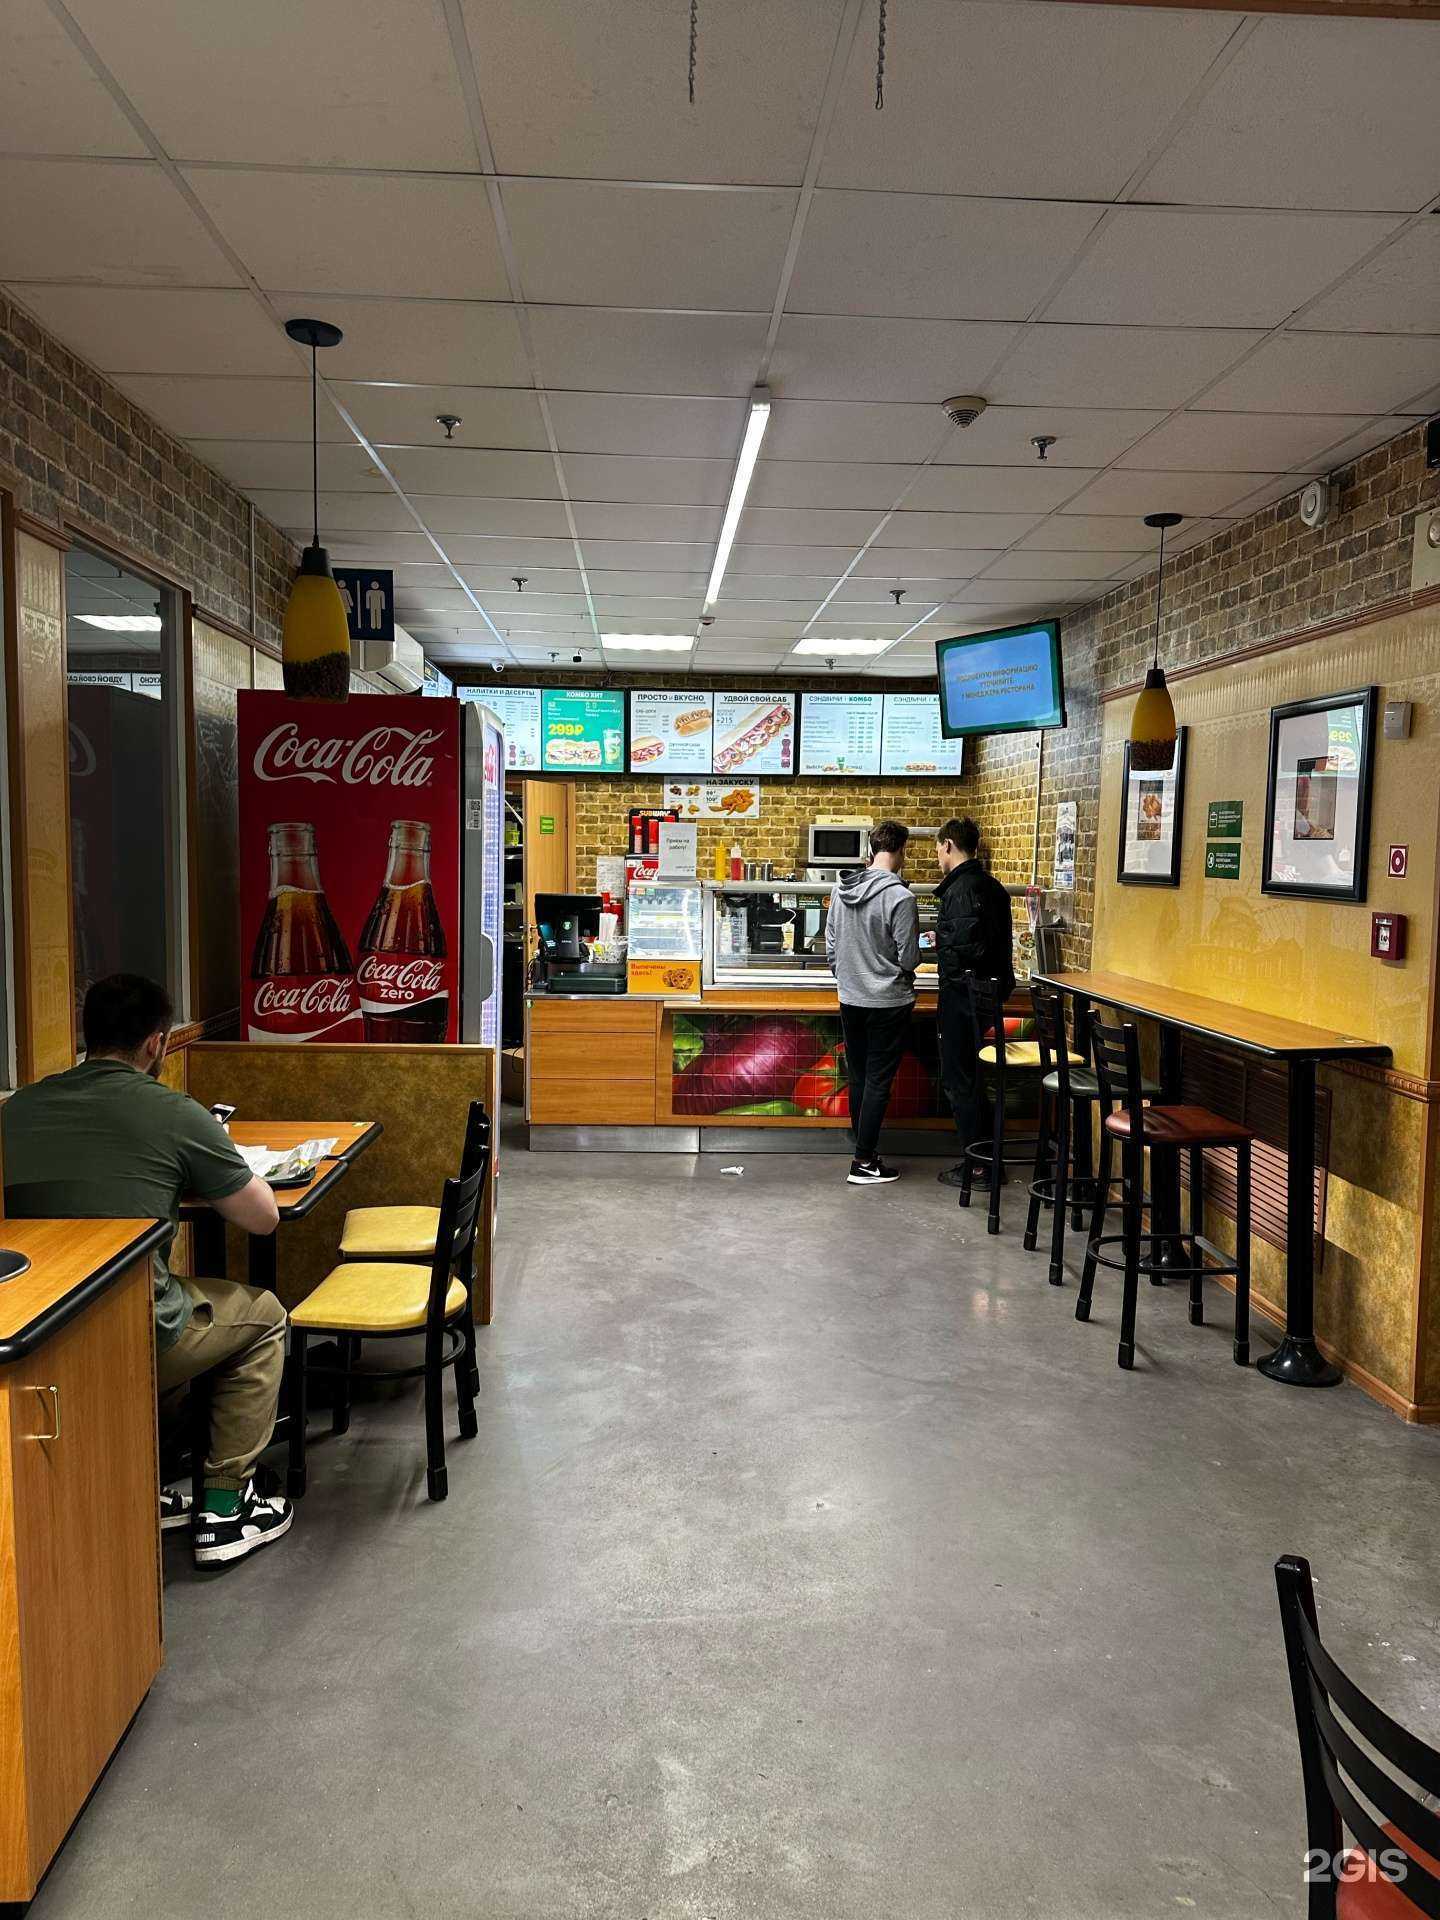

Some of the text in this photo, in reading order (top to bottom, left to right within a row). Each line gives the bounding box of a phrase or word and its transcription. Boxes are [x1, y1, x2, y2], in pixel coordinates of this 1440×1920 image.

[723, 694, 749, 702] УДВОЙ
[750, 694, 771, 702] СВОЙ
[253, 722, 446, 787] Coca-Cola
[706, 778, 754, 786] НА ЗАКУСКУ
[357, 955, 445, 991] Coca-Cola
[253, 978, 354, 1016] Coca-Cola
[379, 987, 415, 1000] zero
